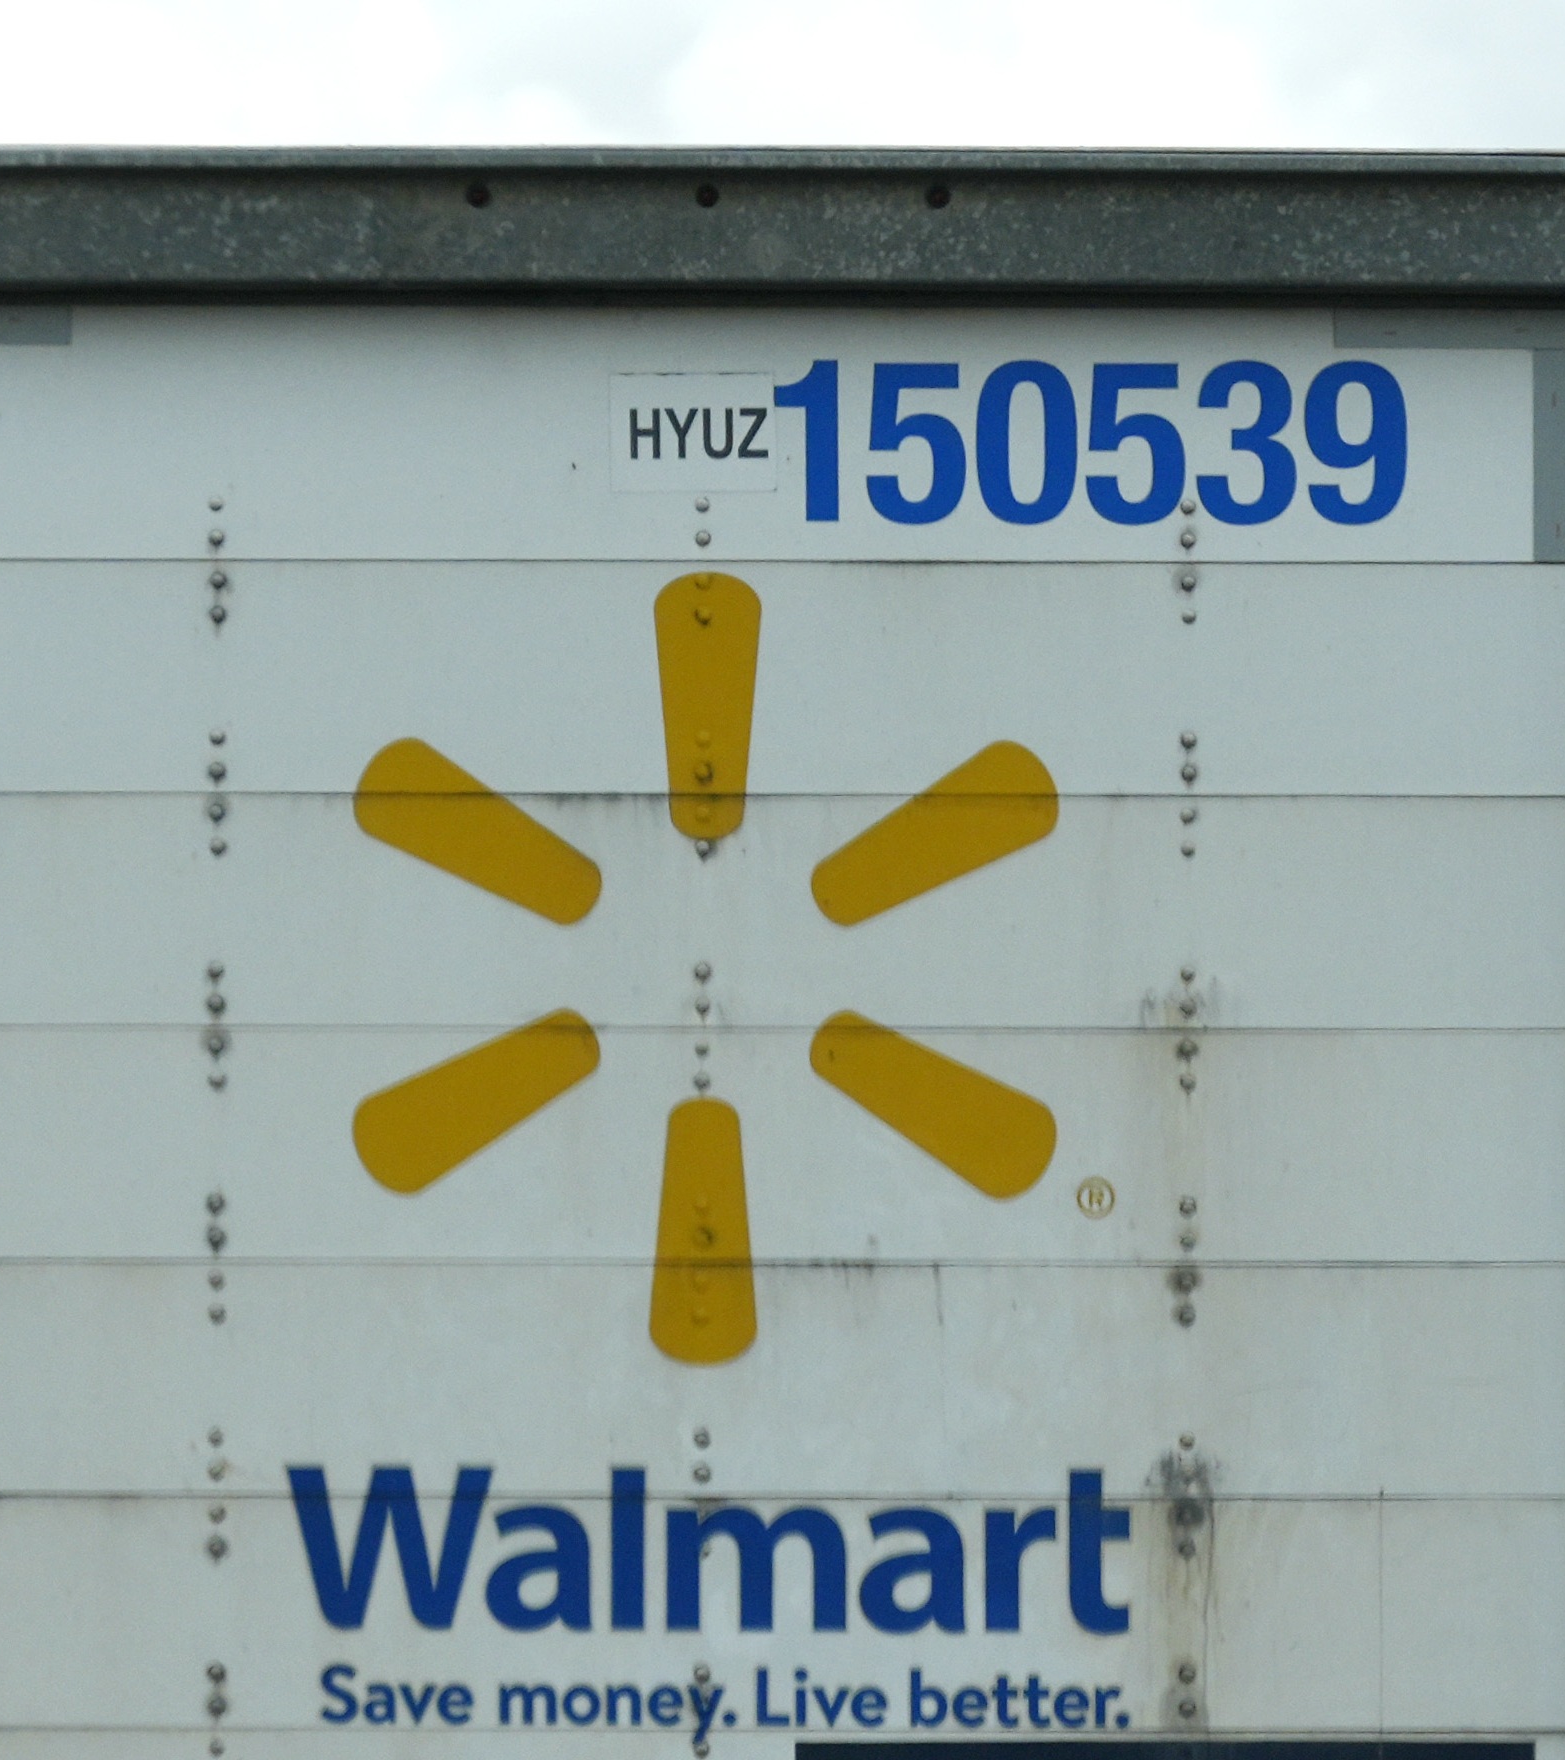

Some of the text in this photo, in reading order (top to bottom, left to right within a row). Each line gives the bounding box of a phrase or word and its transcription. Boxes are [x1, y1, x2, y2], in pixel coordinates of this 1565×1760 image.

[629, 359, 1408, 527] HYUZ 150539
[285, 1464, 1130, 1635] Walmart
[319, 1664, 1131, 1742] Save money. Live better.
